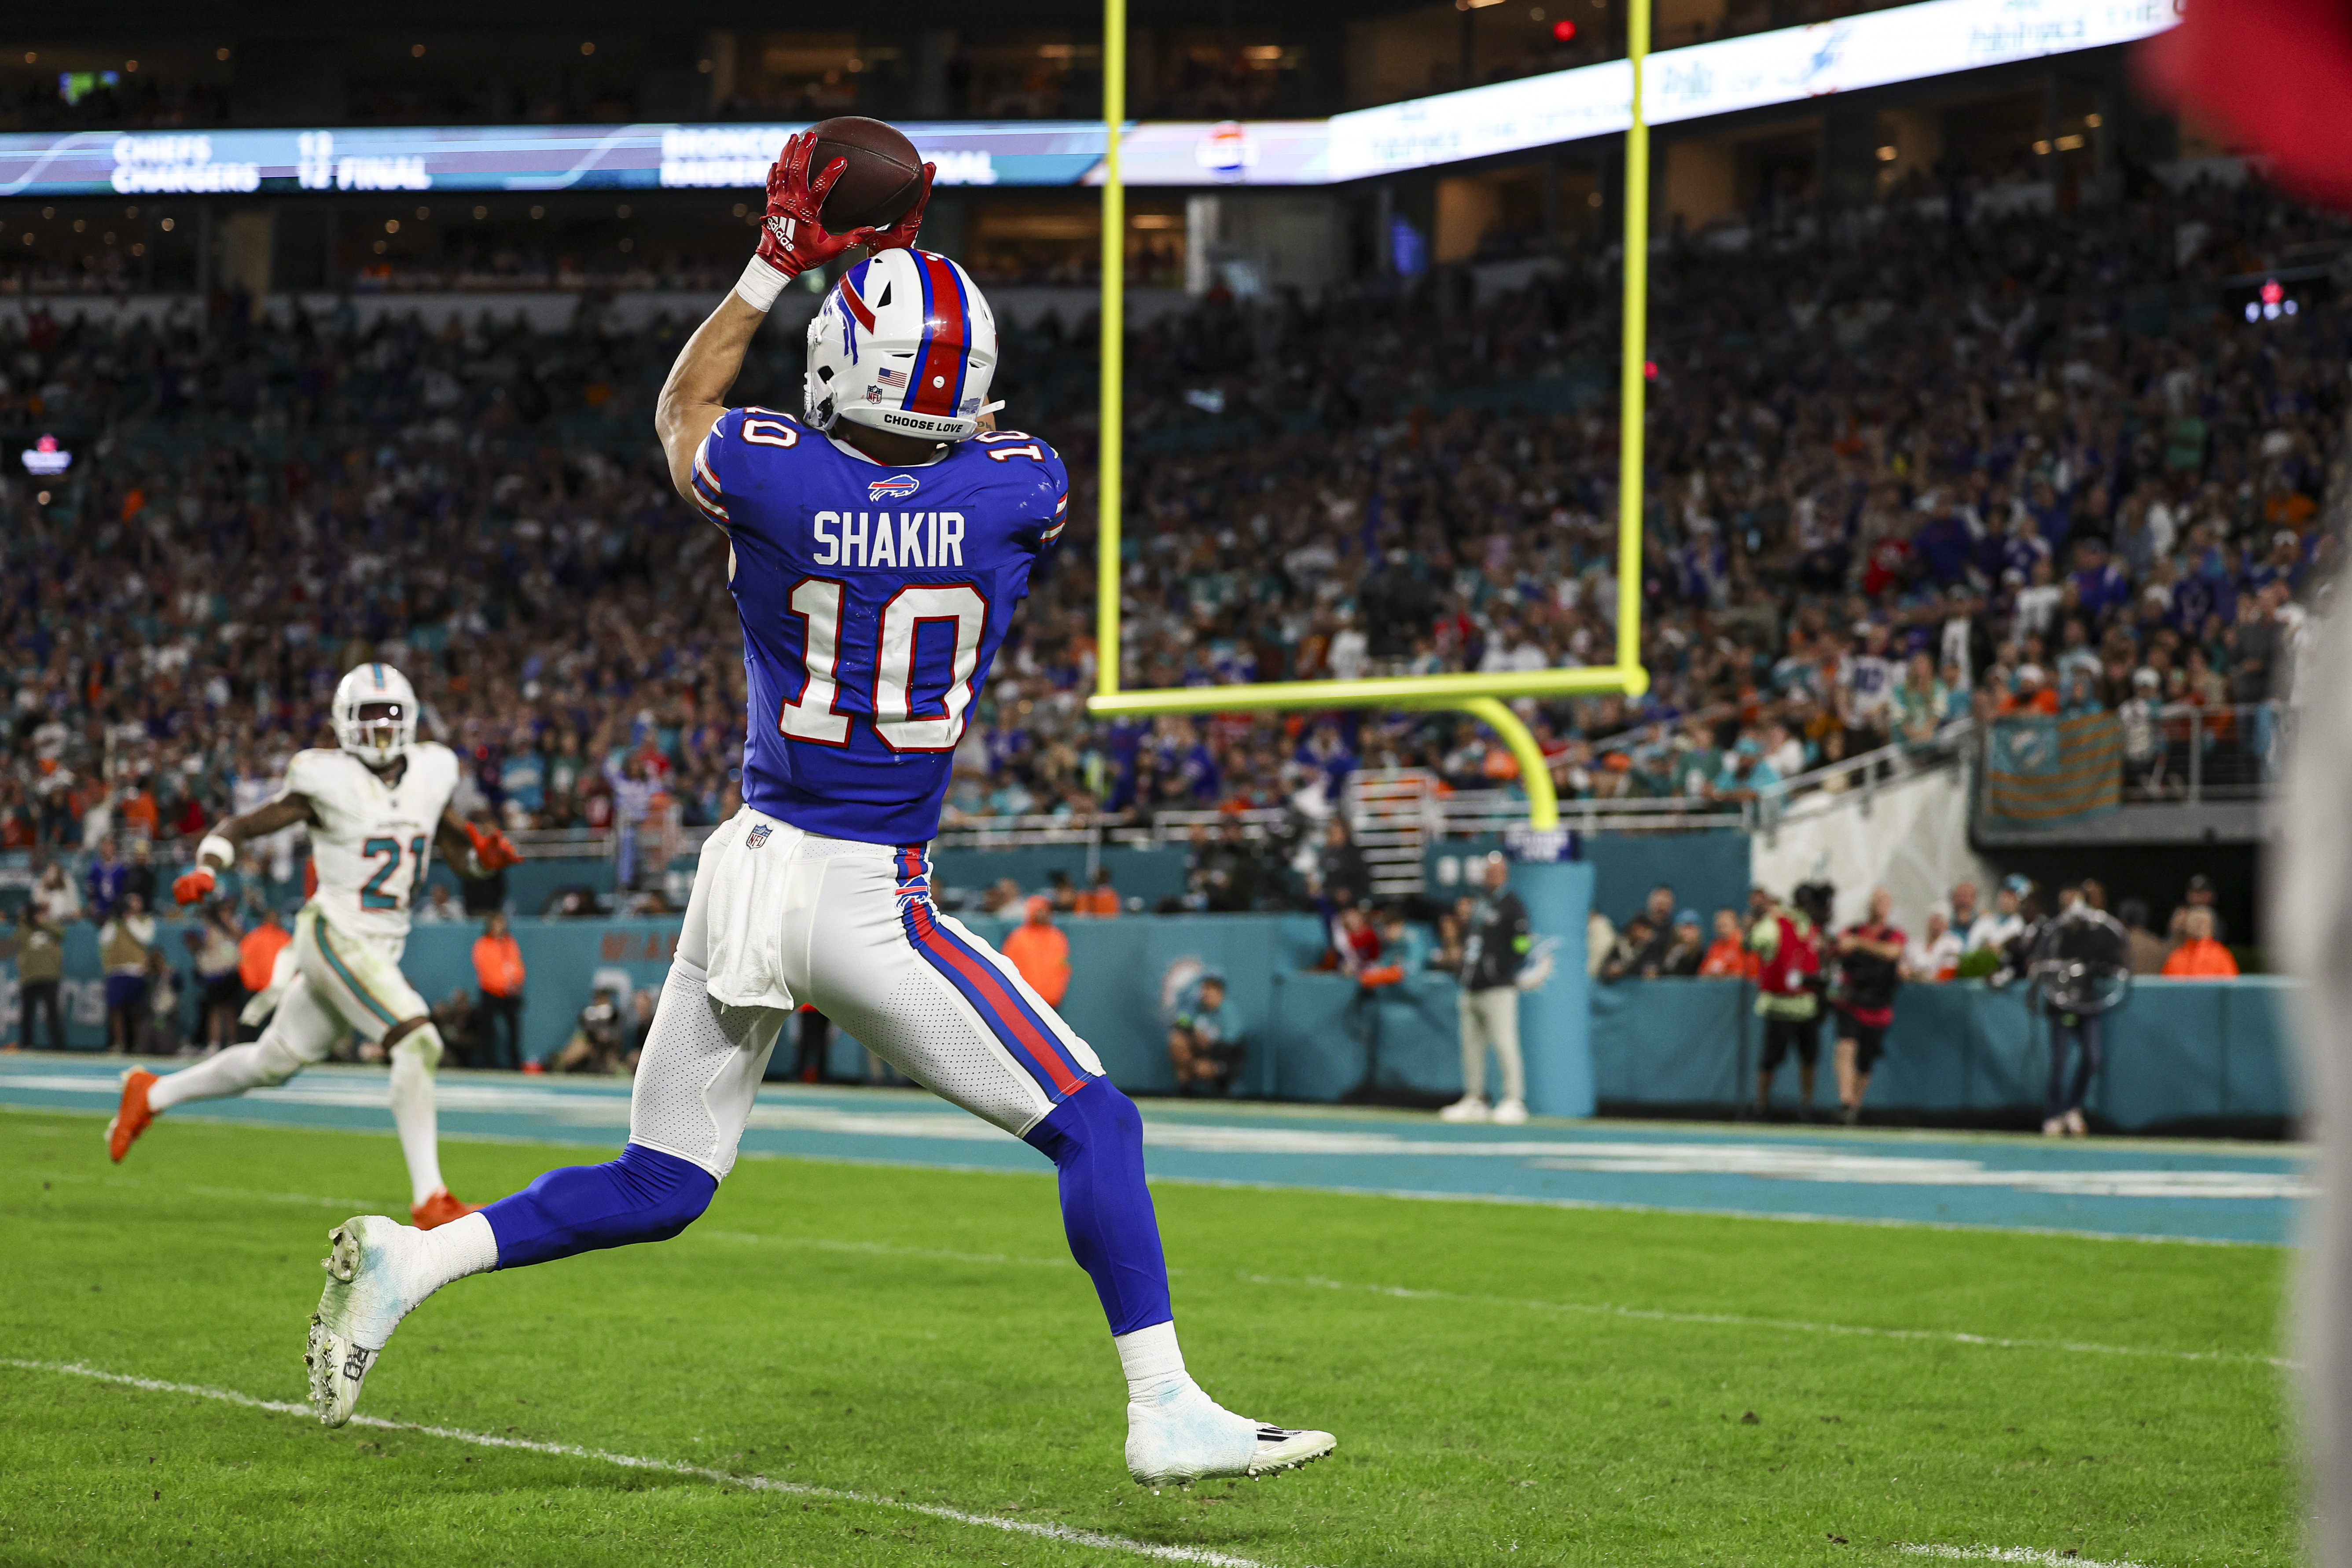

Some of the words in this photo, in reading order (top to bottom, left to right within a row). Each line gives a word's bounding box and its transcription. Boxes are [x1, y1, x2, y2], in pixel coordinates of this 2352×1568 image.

[113, 136, 213, 161] CHIEFS
[111, 162, 261, 194] CHARGERS
[337, 155, 433, 191] FINAL
[767, 217, 794, 252] adidas
[867, 392, 881, 402] NFL
[884, 414, 934, 431] CHOOSE
[937, 422, 963, 433] LOVE
[974, 430, 1046, 463] 10
[813, 511, 964, 567] SHAKIR
[777, 575, 989, 753] 10
[748, 834, 764, 847] NFL
[359, 834, 427, 911] 21
